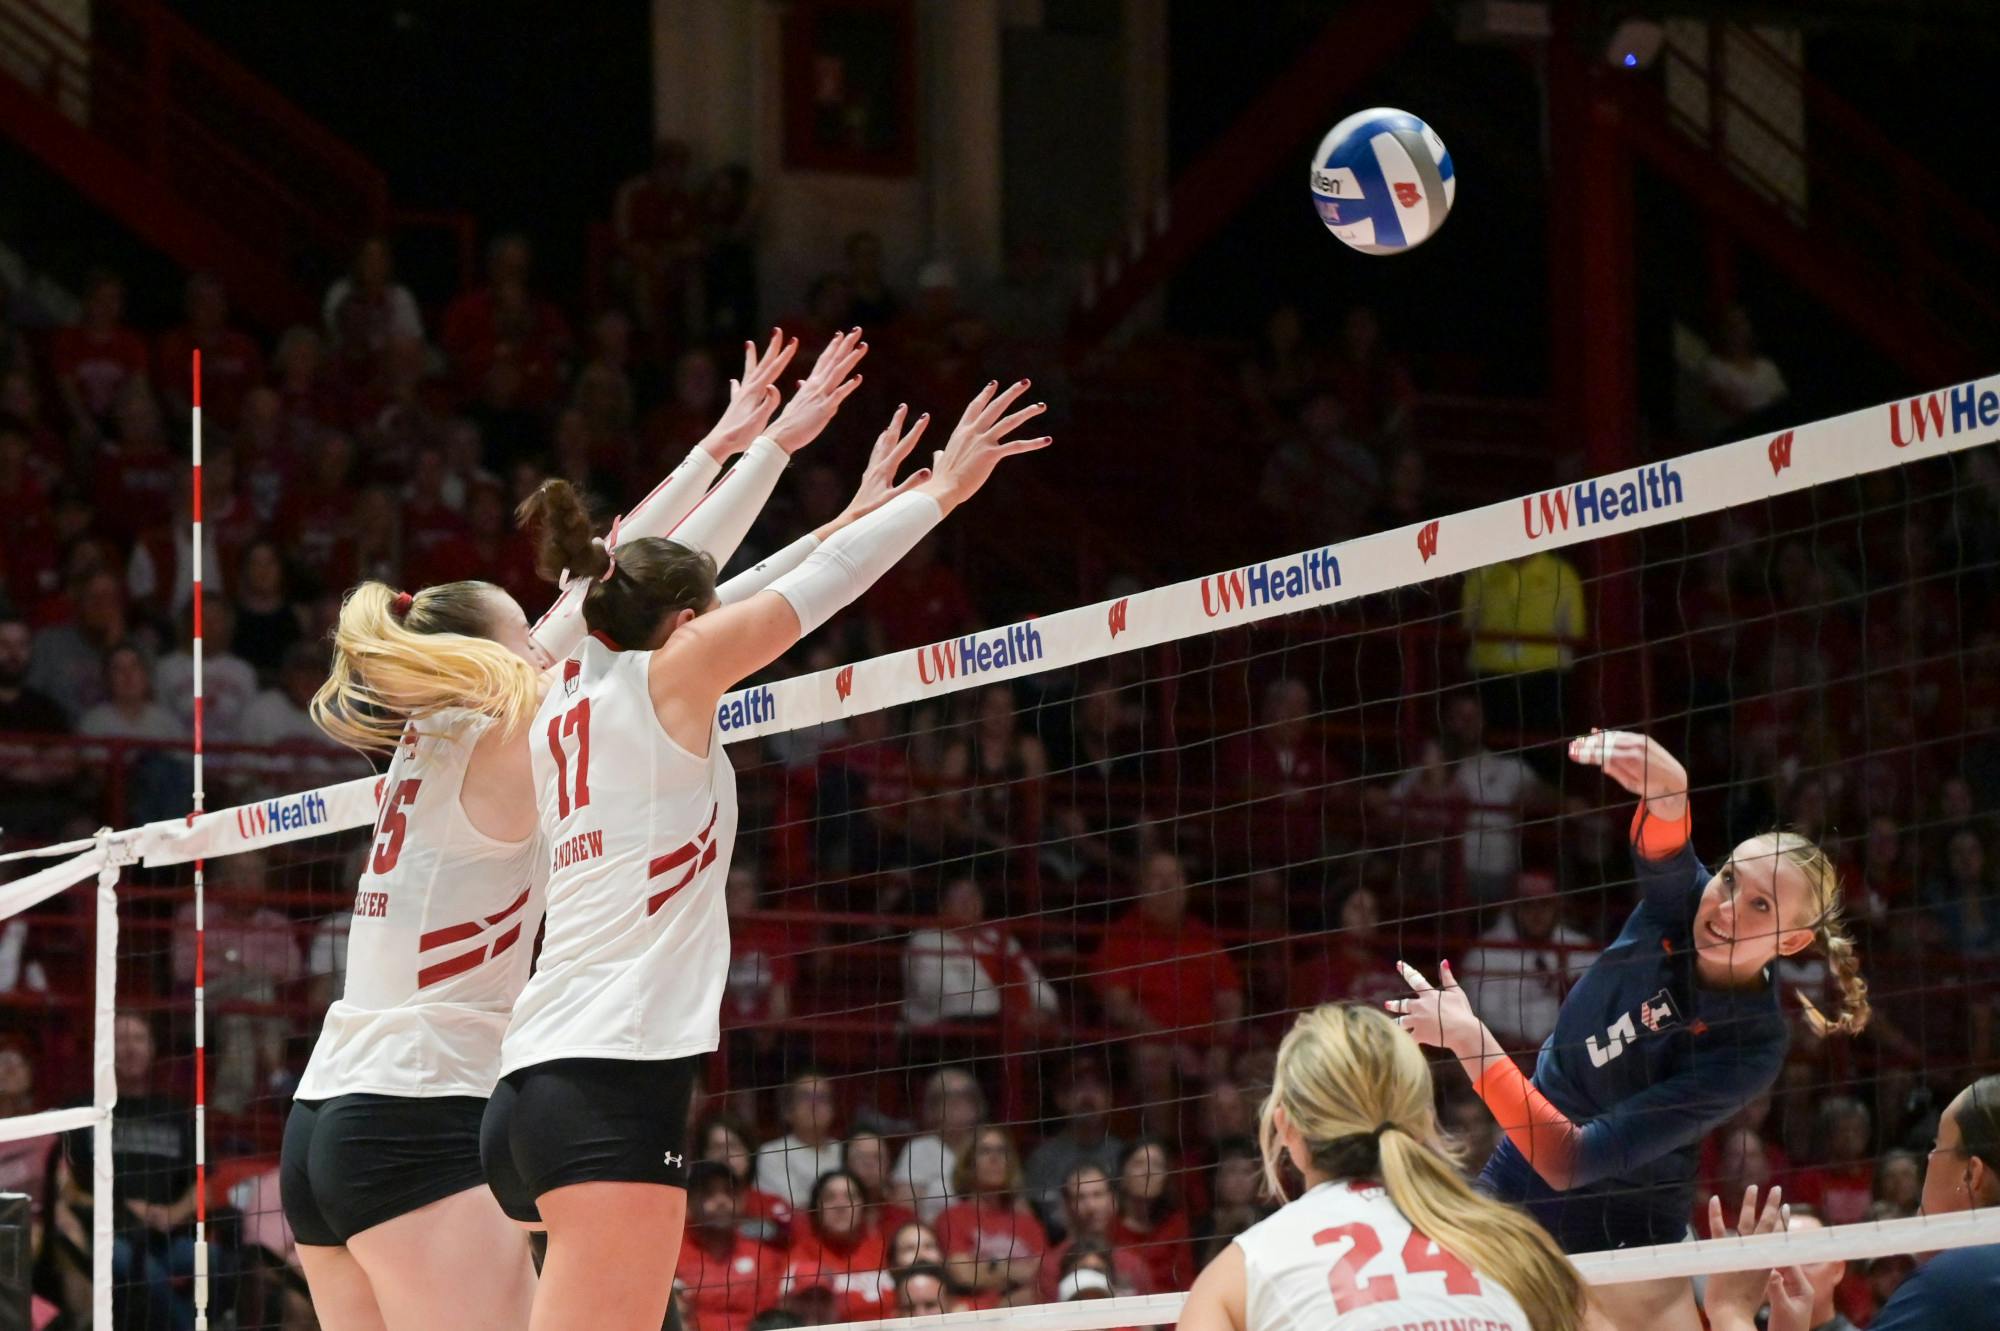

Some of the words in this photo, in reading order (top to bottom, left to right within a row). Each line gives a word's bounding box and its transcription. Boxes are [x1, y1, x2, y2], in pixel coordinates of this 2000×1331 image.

[547, 698, 590, 820] 17
[362, 779, 422, 875] 5
[553, 829, 603, 874] ANDREW
[355, 892, 389, 918] LYER
[1585, 1011, 1637, 1068] 5
[1312, 1221, 1483, 1316] 24
